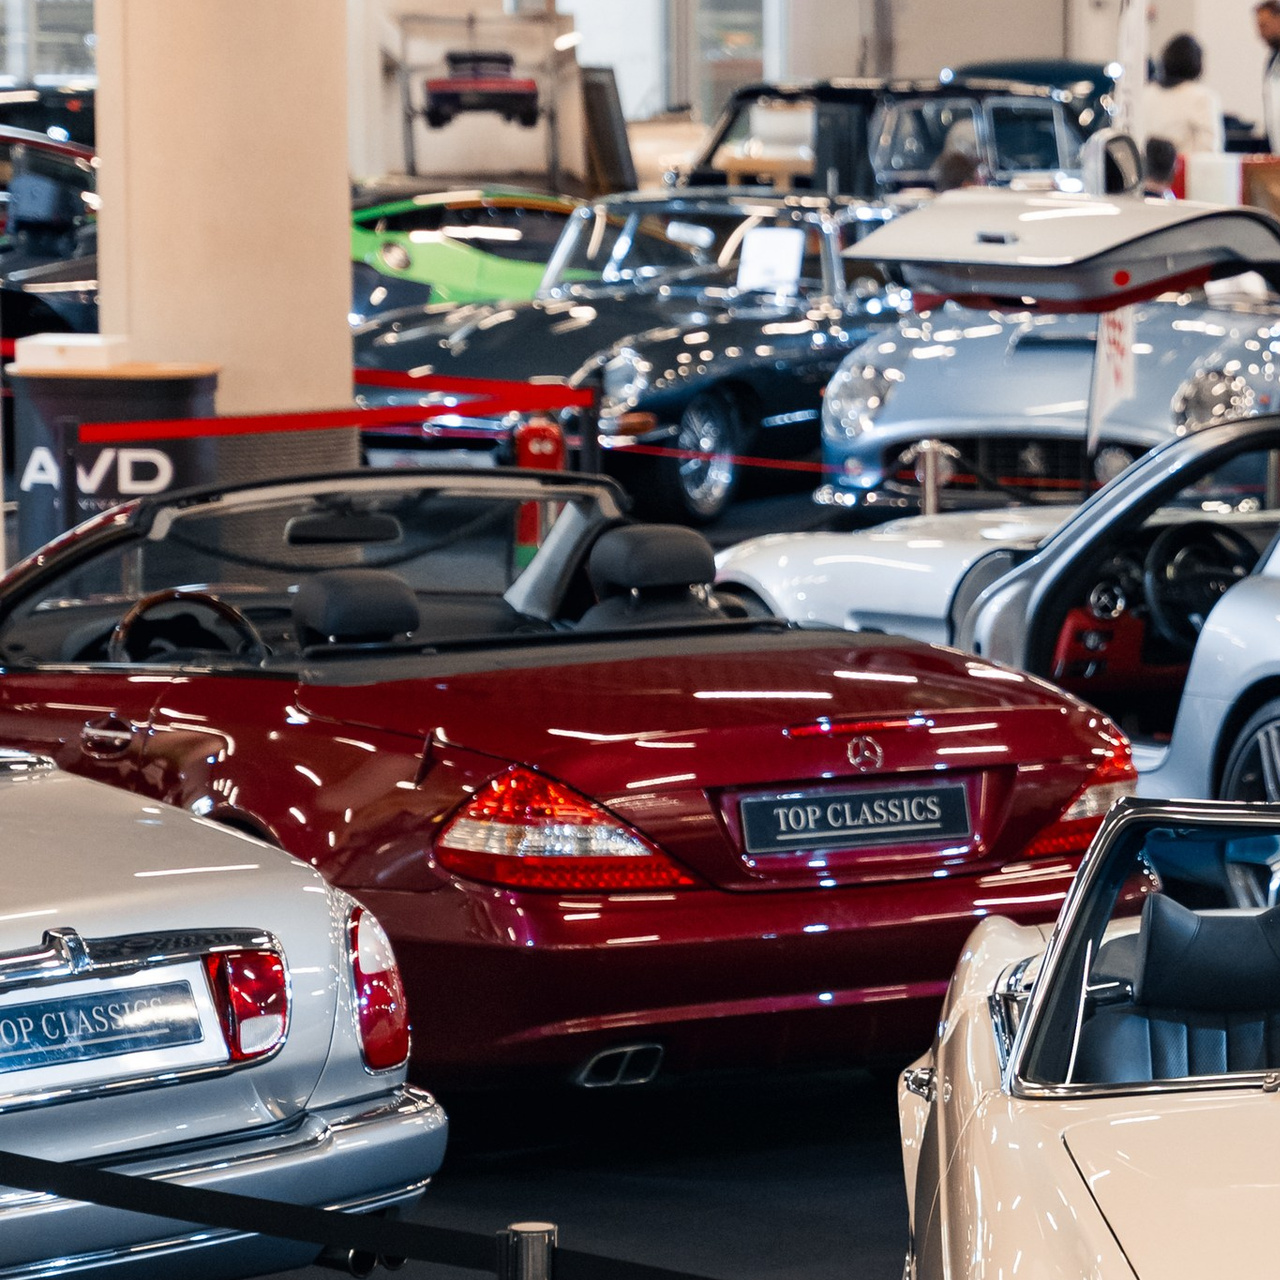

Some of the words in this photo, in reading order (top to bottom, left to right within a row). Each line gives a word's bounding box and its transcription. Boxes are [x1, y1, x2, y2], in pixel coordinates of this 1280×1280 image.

[20, 446, 173, 494] AVD
[773, 805, 820, 832] TOP
[827, 795, 942, 828] CLASSICS
[0, 1016, 34, 1046] OP
